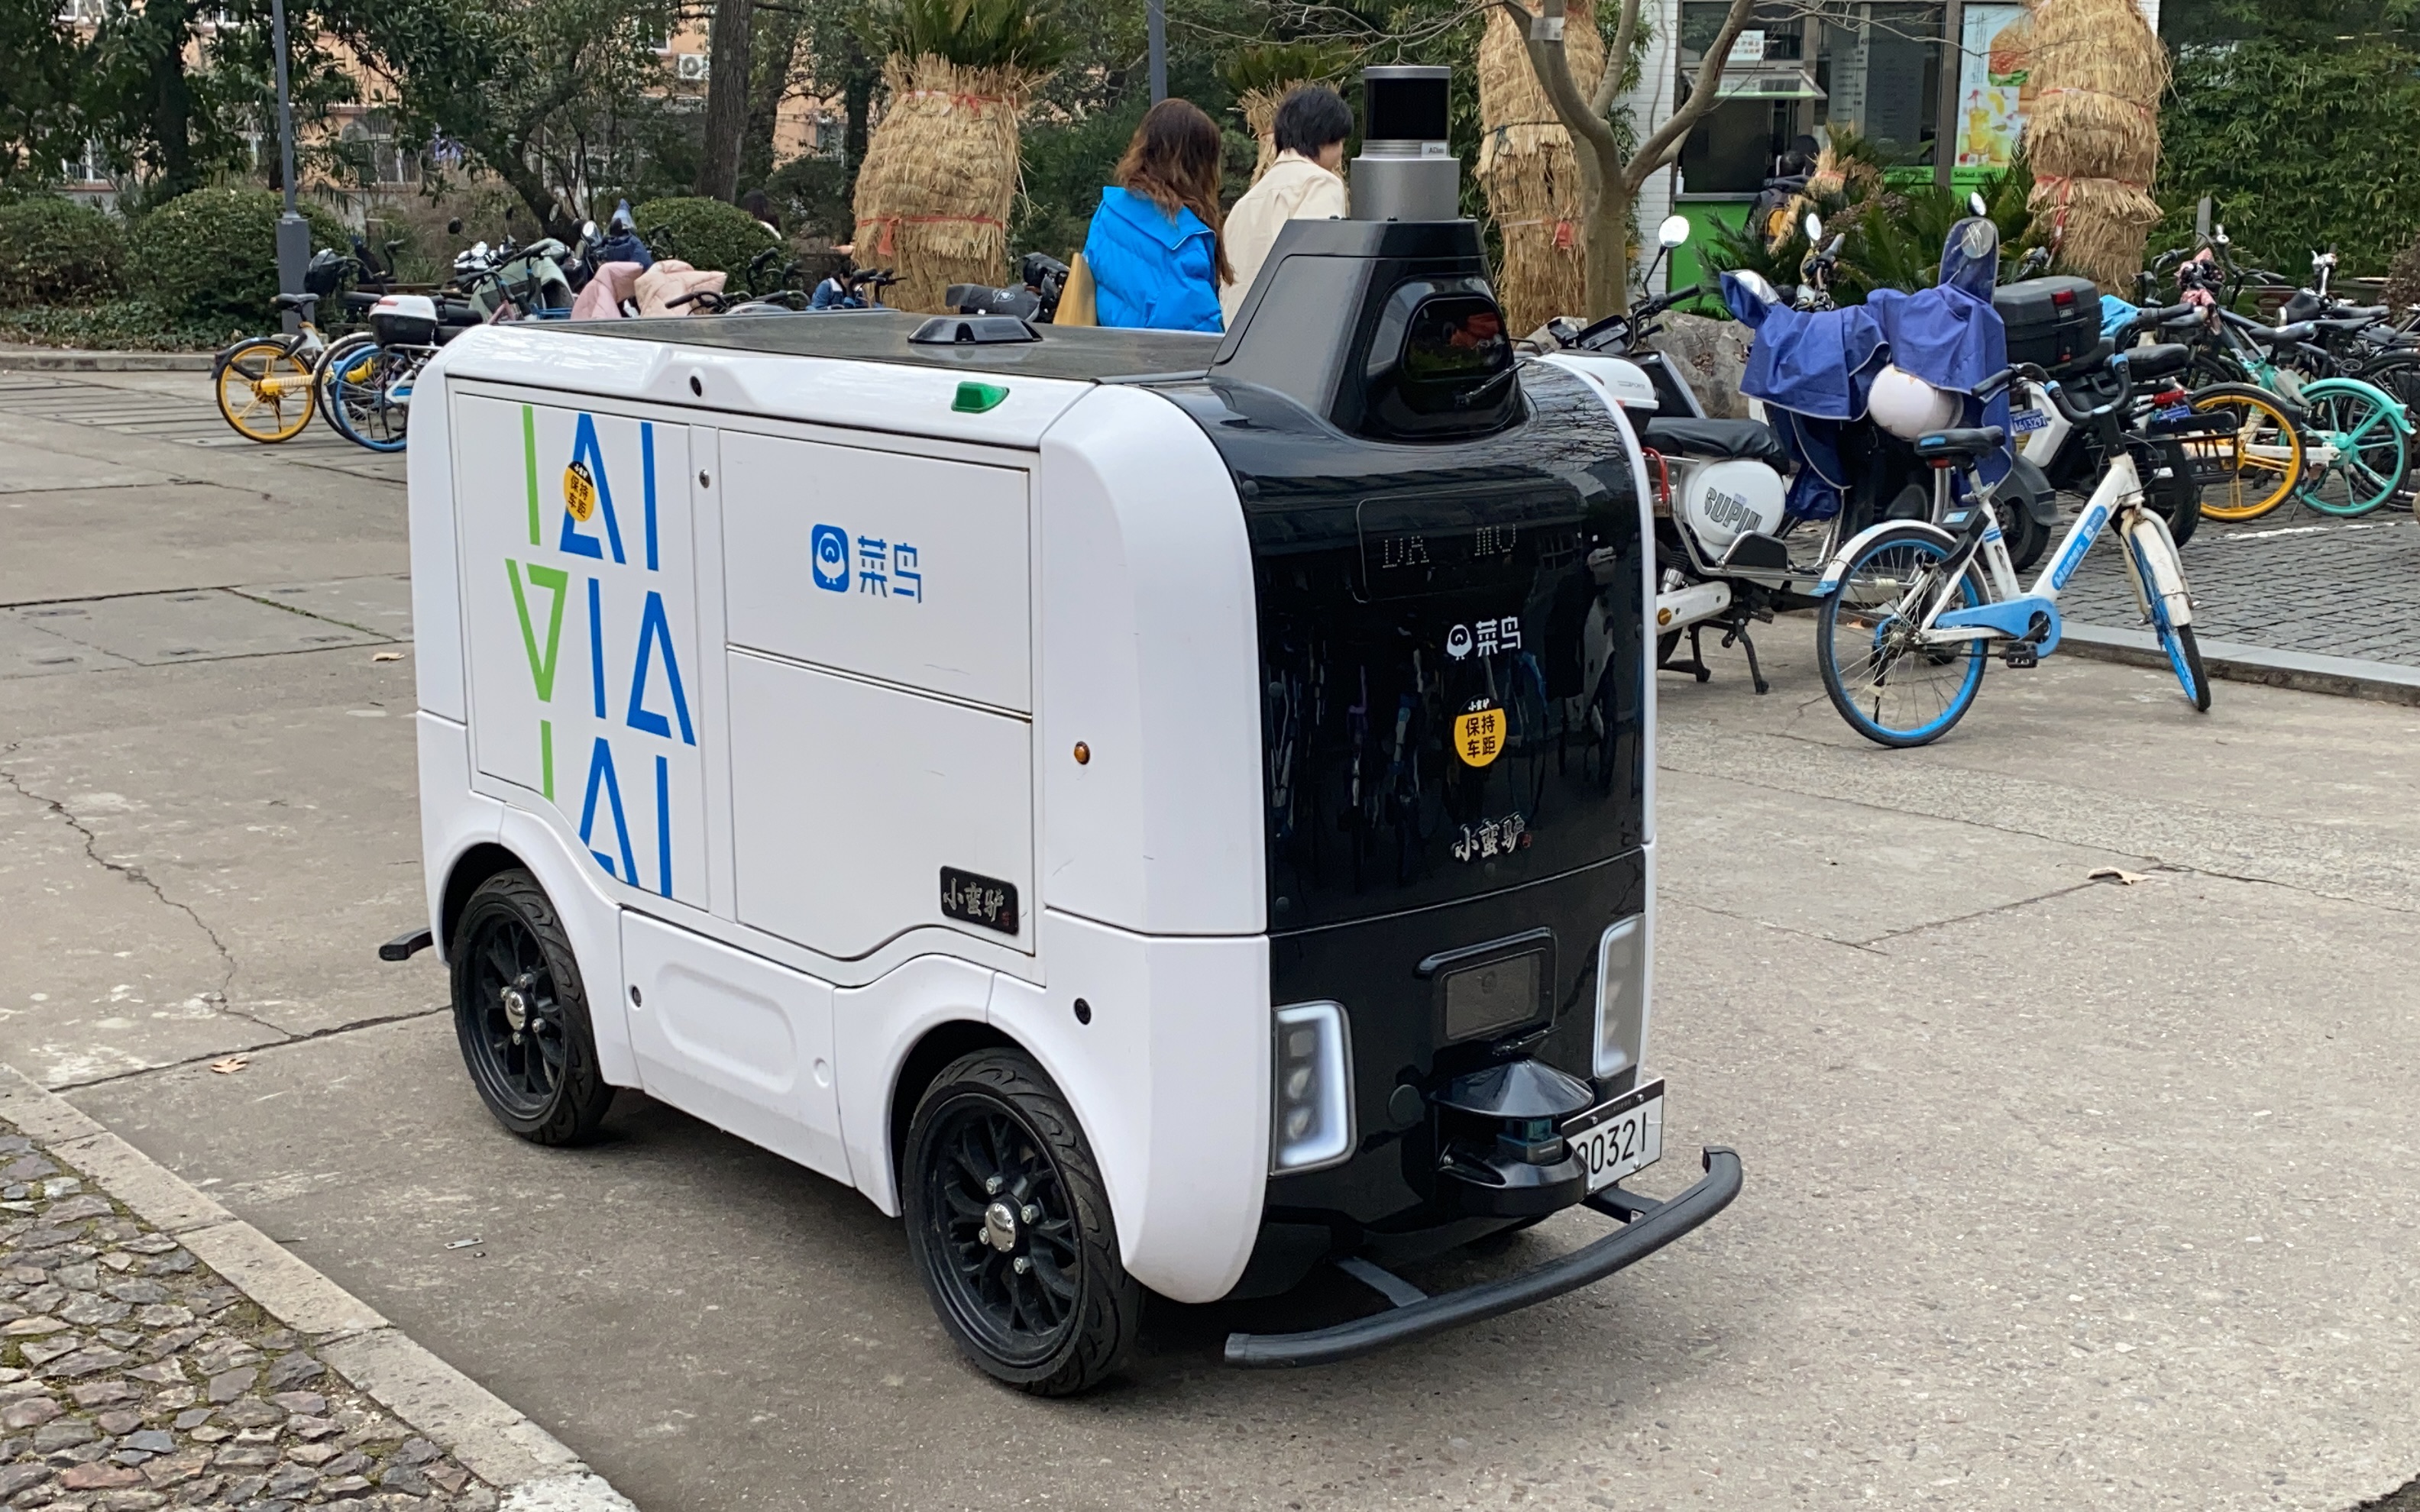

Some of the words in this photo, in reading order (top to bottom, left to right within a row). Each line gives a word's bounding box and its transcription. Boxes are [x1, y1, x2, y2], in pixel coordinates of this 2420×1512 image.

[857, 535, 922, 604] 菜鸟
[1475, 615, 1522, 657] 菜鸟
[1466, 714, 1495, 738] 保持
[1467, 735, 1496, 758] 车距
[1454, 814, 1525, 861] 小蛮驴
[943, 877, 1005, 922] 小蛮驴
